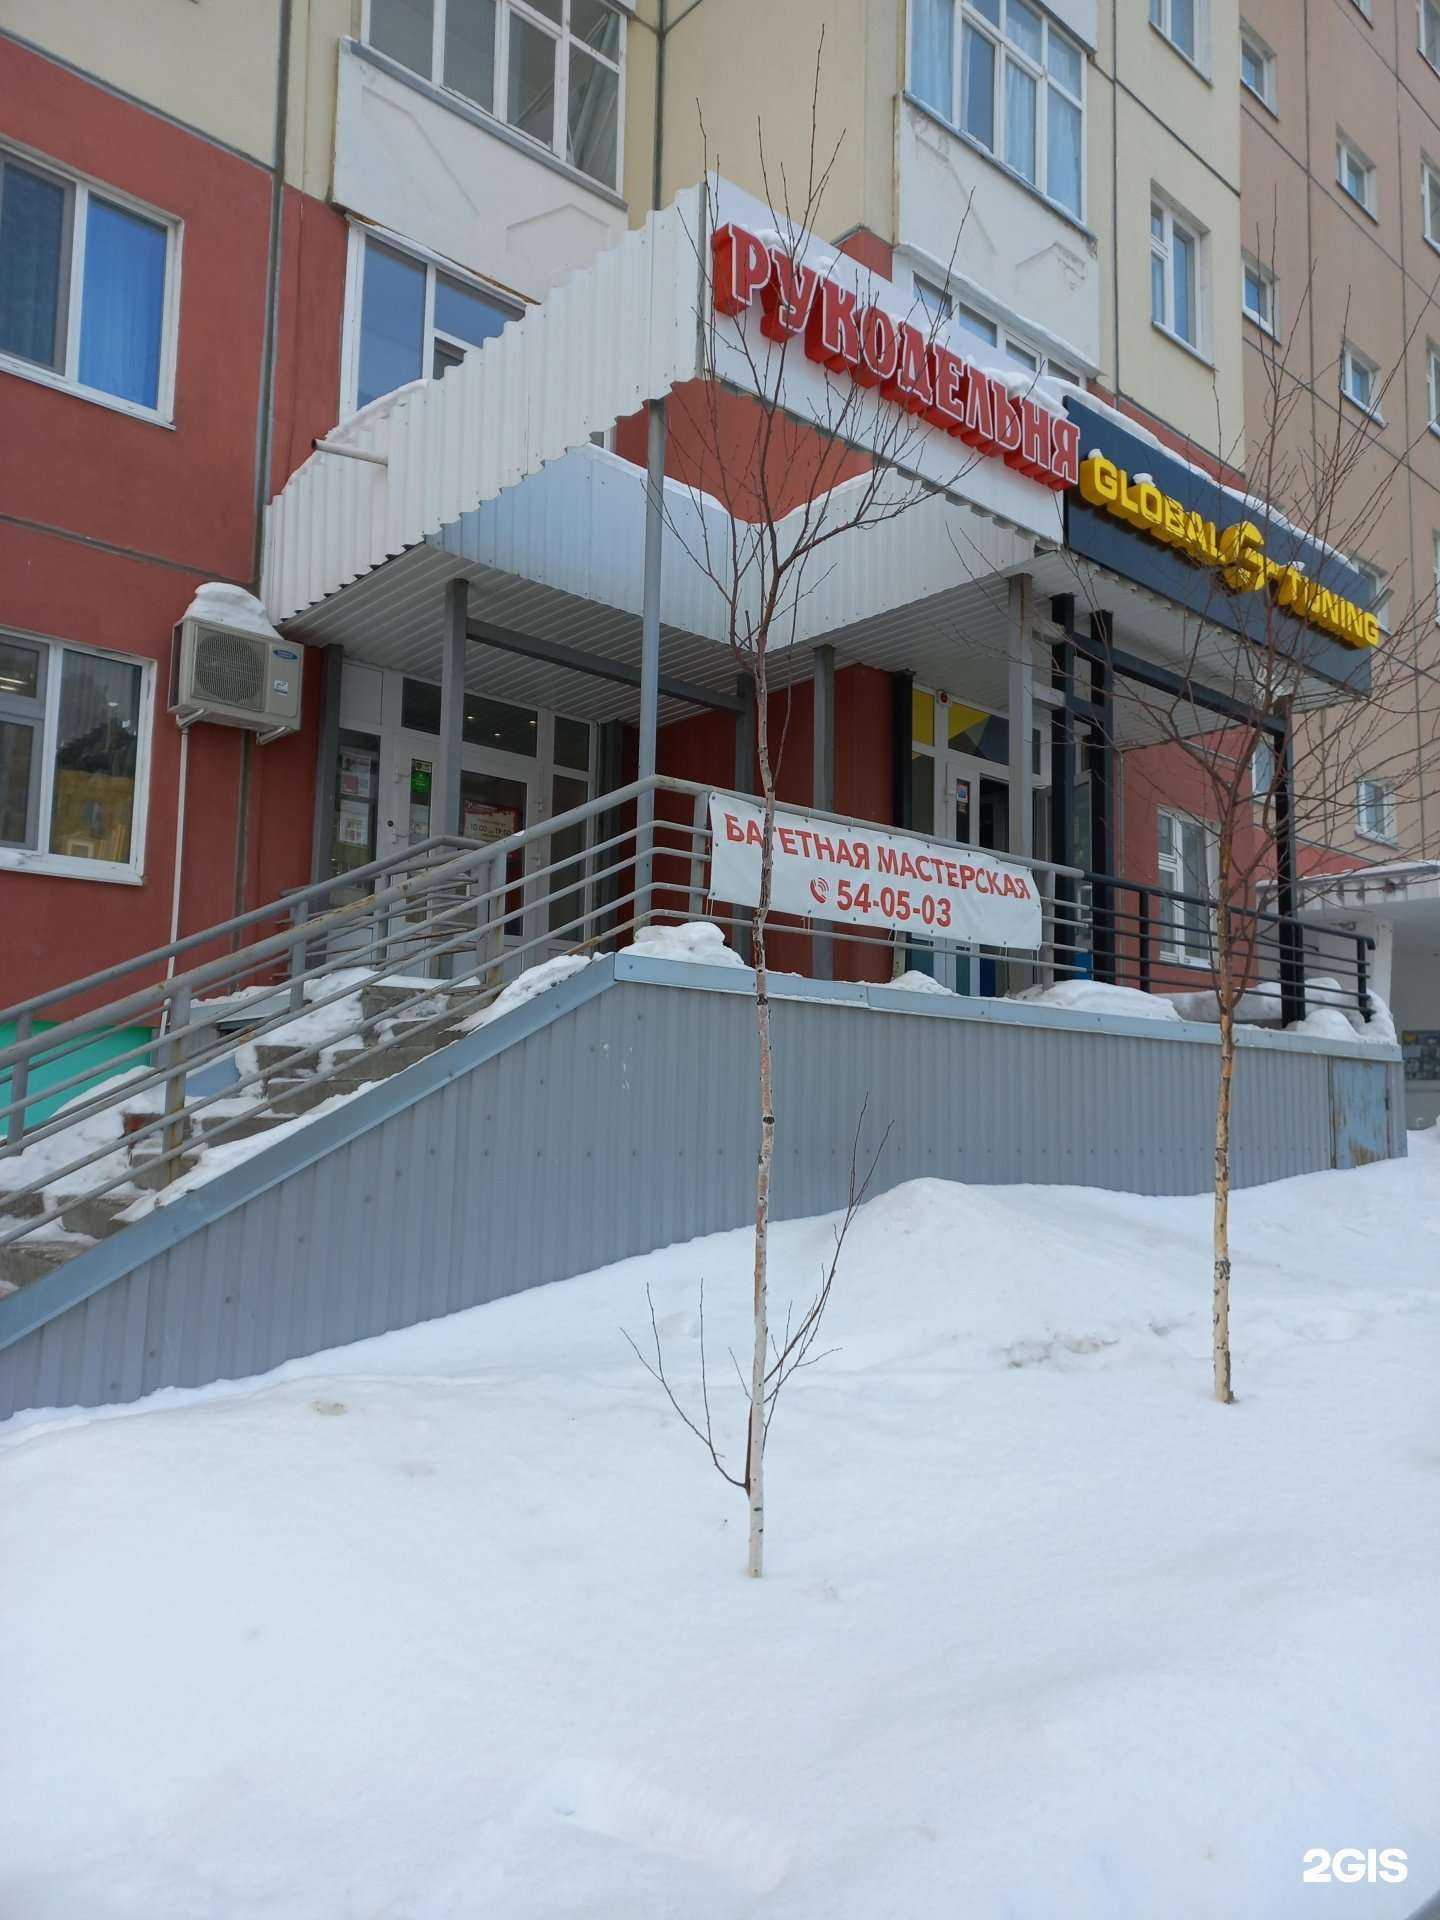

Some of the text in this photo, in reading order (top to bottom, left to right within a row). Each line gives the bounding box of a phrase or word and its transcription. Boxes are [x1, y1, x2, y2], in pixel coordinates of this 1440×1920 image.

[716, 221, 1080, 485] РУКОДЕЛЬНЯ
[1085, 456, 1226, 564] GLOBAL
[1281, 564, 1380, 647] TUNING
[725, 813, 1031, 900] БАЕТНАЯ МАСТЕРСКАЯ
[836, 879, 951, 928] 54-05-03
